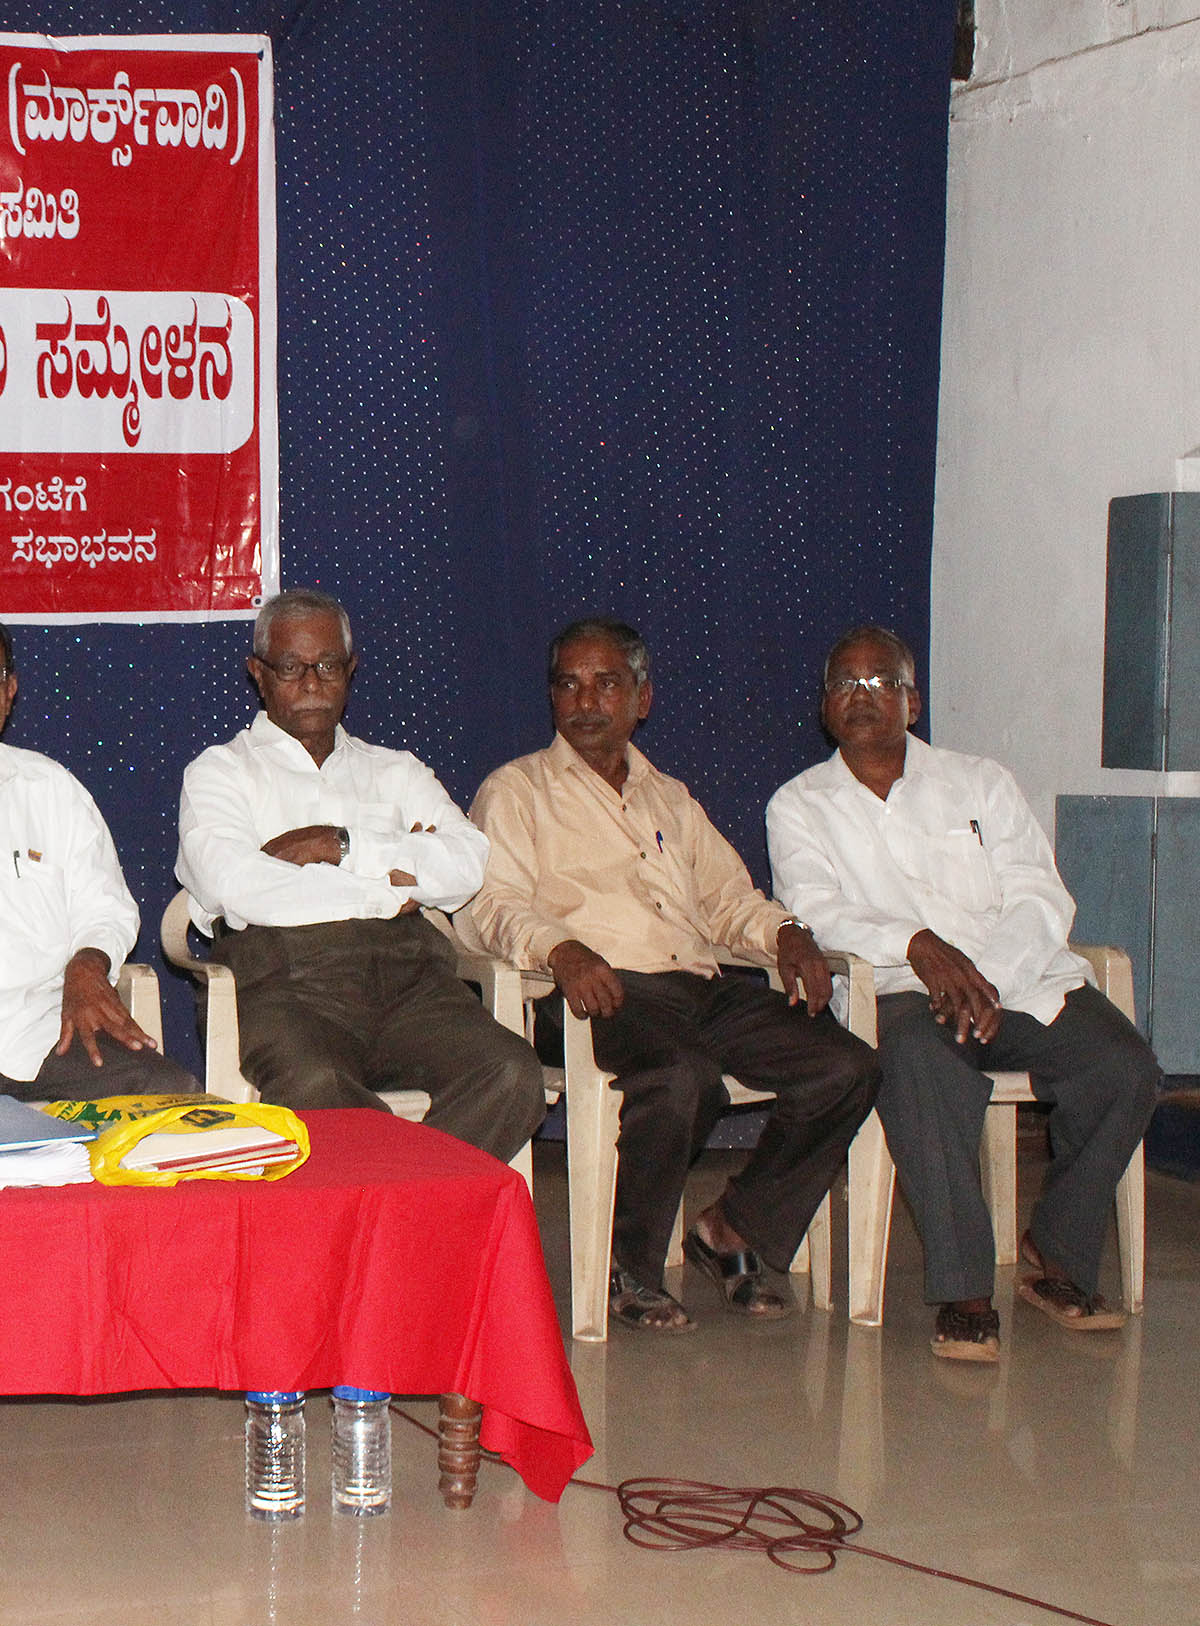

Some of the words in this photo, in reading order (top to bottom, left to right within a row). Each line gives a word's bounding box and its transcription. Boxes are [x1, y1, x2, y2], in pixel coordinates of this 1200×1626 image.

[0, 176, 80, 239] ಸಮಿತಿ
[35, 295, 234, 447] ಸಮ್ಮೇಳನ
[11, 528, 157, 569] ಸಭಾಭವನ
